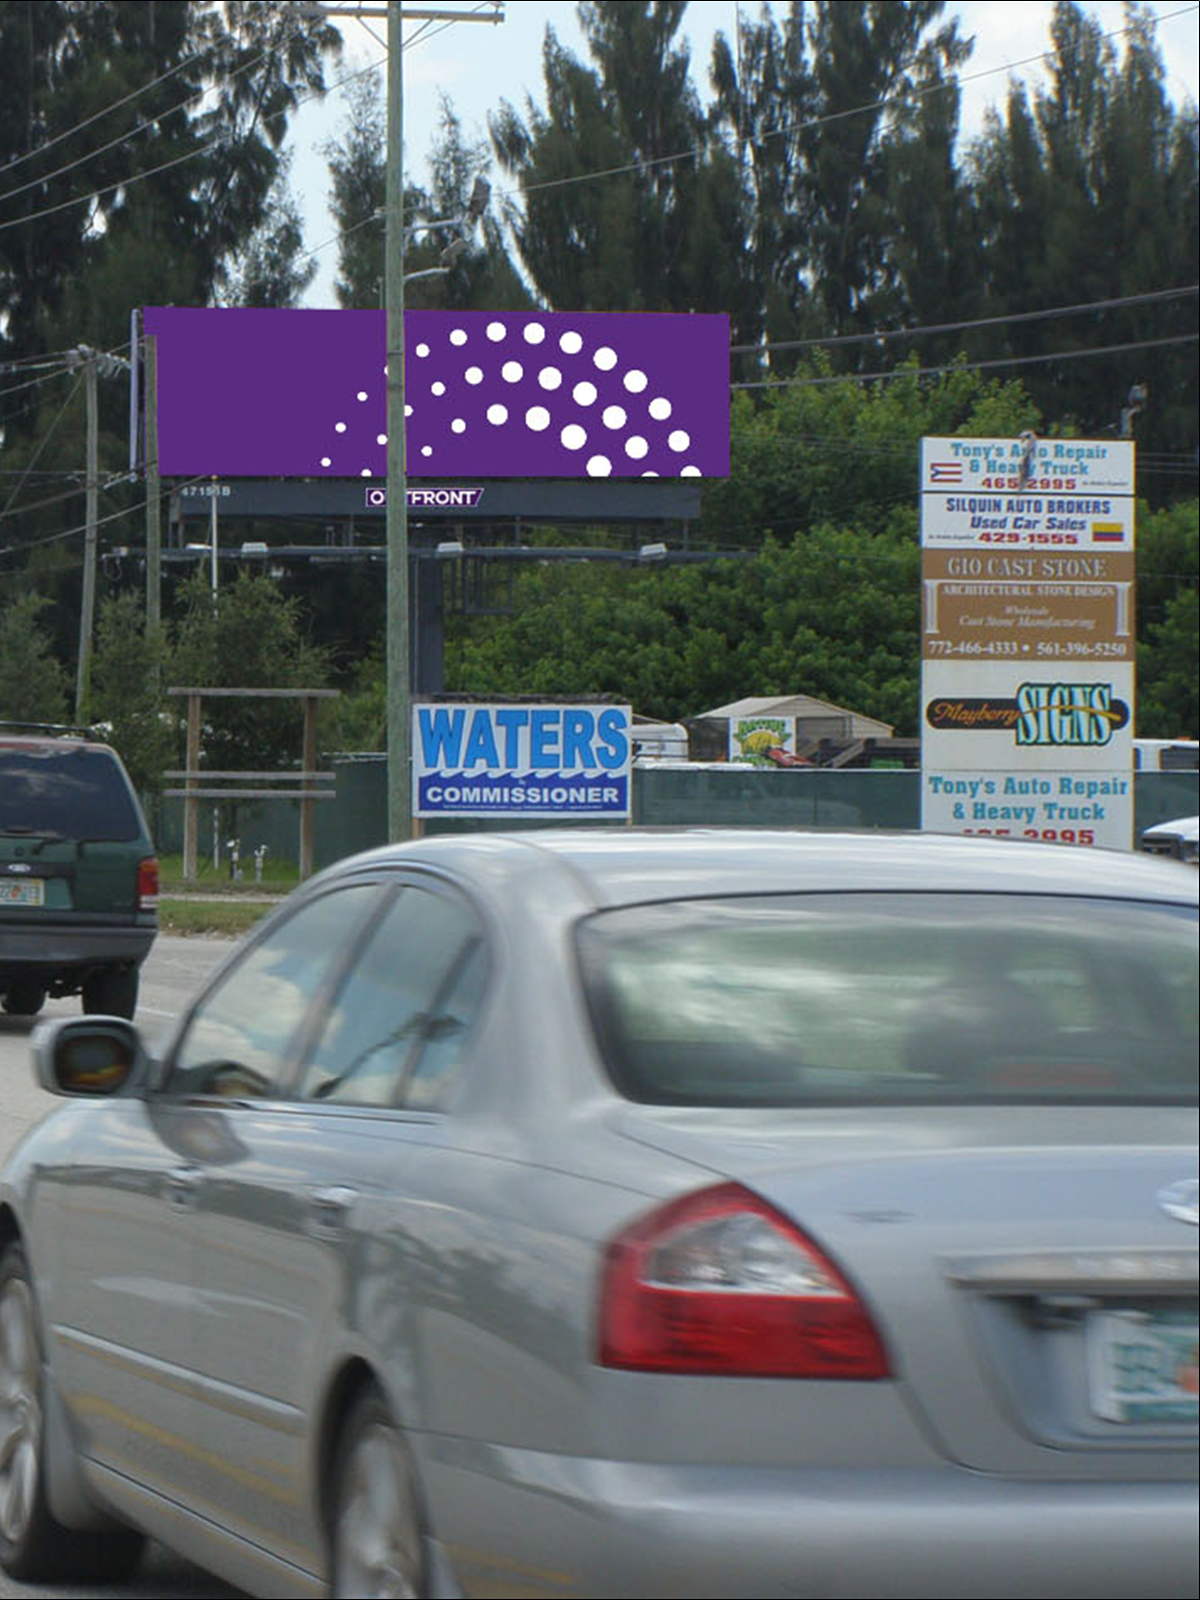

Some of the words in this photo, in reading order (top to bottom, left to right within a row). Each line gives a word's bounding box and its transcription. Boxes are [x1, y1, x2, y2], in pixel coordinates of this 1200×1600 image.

[951, 443, 1004, 460] Tony's
[1053, 444, 1108, 461] Repair
[969, 459, 980, 474] &
[1040, 460, 1090, 476] Truck
[981, 477, 1077, 490] 4652995
[369, 490, 477, 505] OFRONT
[946, 498, 1001, 515] SILQUIN
[1006, 499, 1043, 514] AUTO
[1047, 499, 1111, 515] BROKERS
[970, 516, 1010, 529] Used
[1012, 516, 1041, 530] Car
[1046, 517, 1087, 531] Sales
[977, 532, 1079, 545] 429-1555
[987, 557, 1037, 577] CAST
[1042, 558, 1107, 578] STONE
[942, 584, 1033, 597] ARCHITECTURAL
[1036, 585, 1072, 597] STONE
[934, 701, 1021, 726] Mayberry
[1016, 683, 1112, 745] SIGNS
[419, 708, 629, 770] WATERS
[426, 786, 619, 804] COMMISSIONER
[928, 775, 996, 799] Tony's
[1003, 776, 1051, 795] Auto
[1058, 777, 1128, 799] Repair
[952, 802, 965, 820] &
[972, 802, 1037, 824] Heavy
[1043, 802, 1105, 820] Truck
